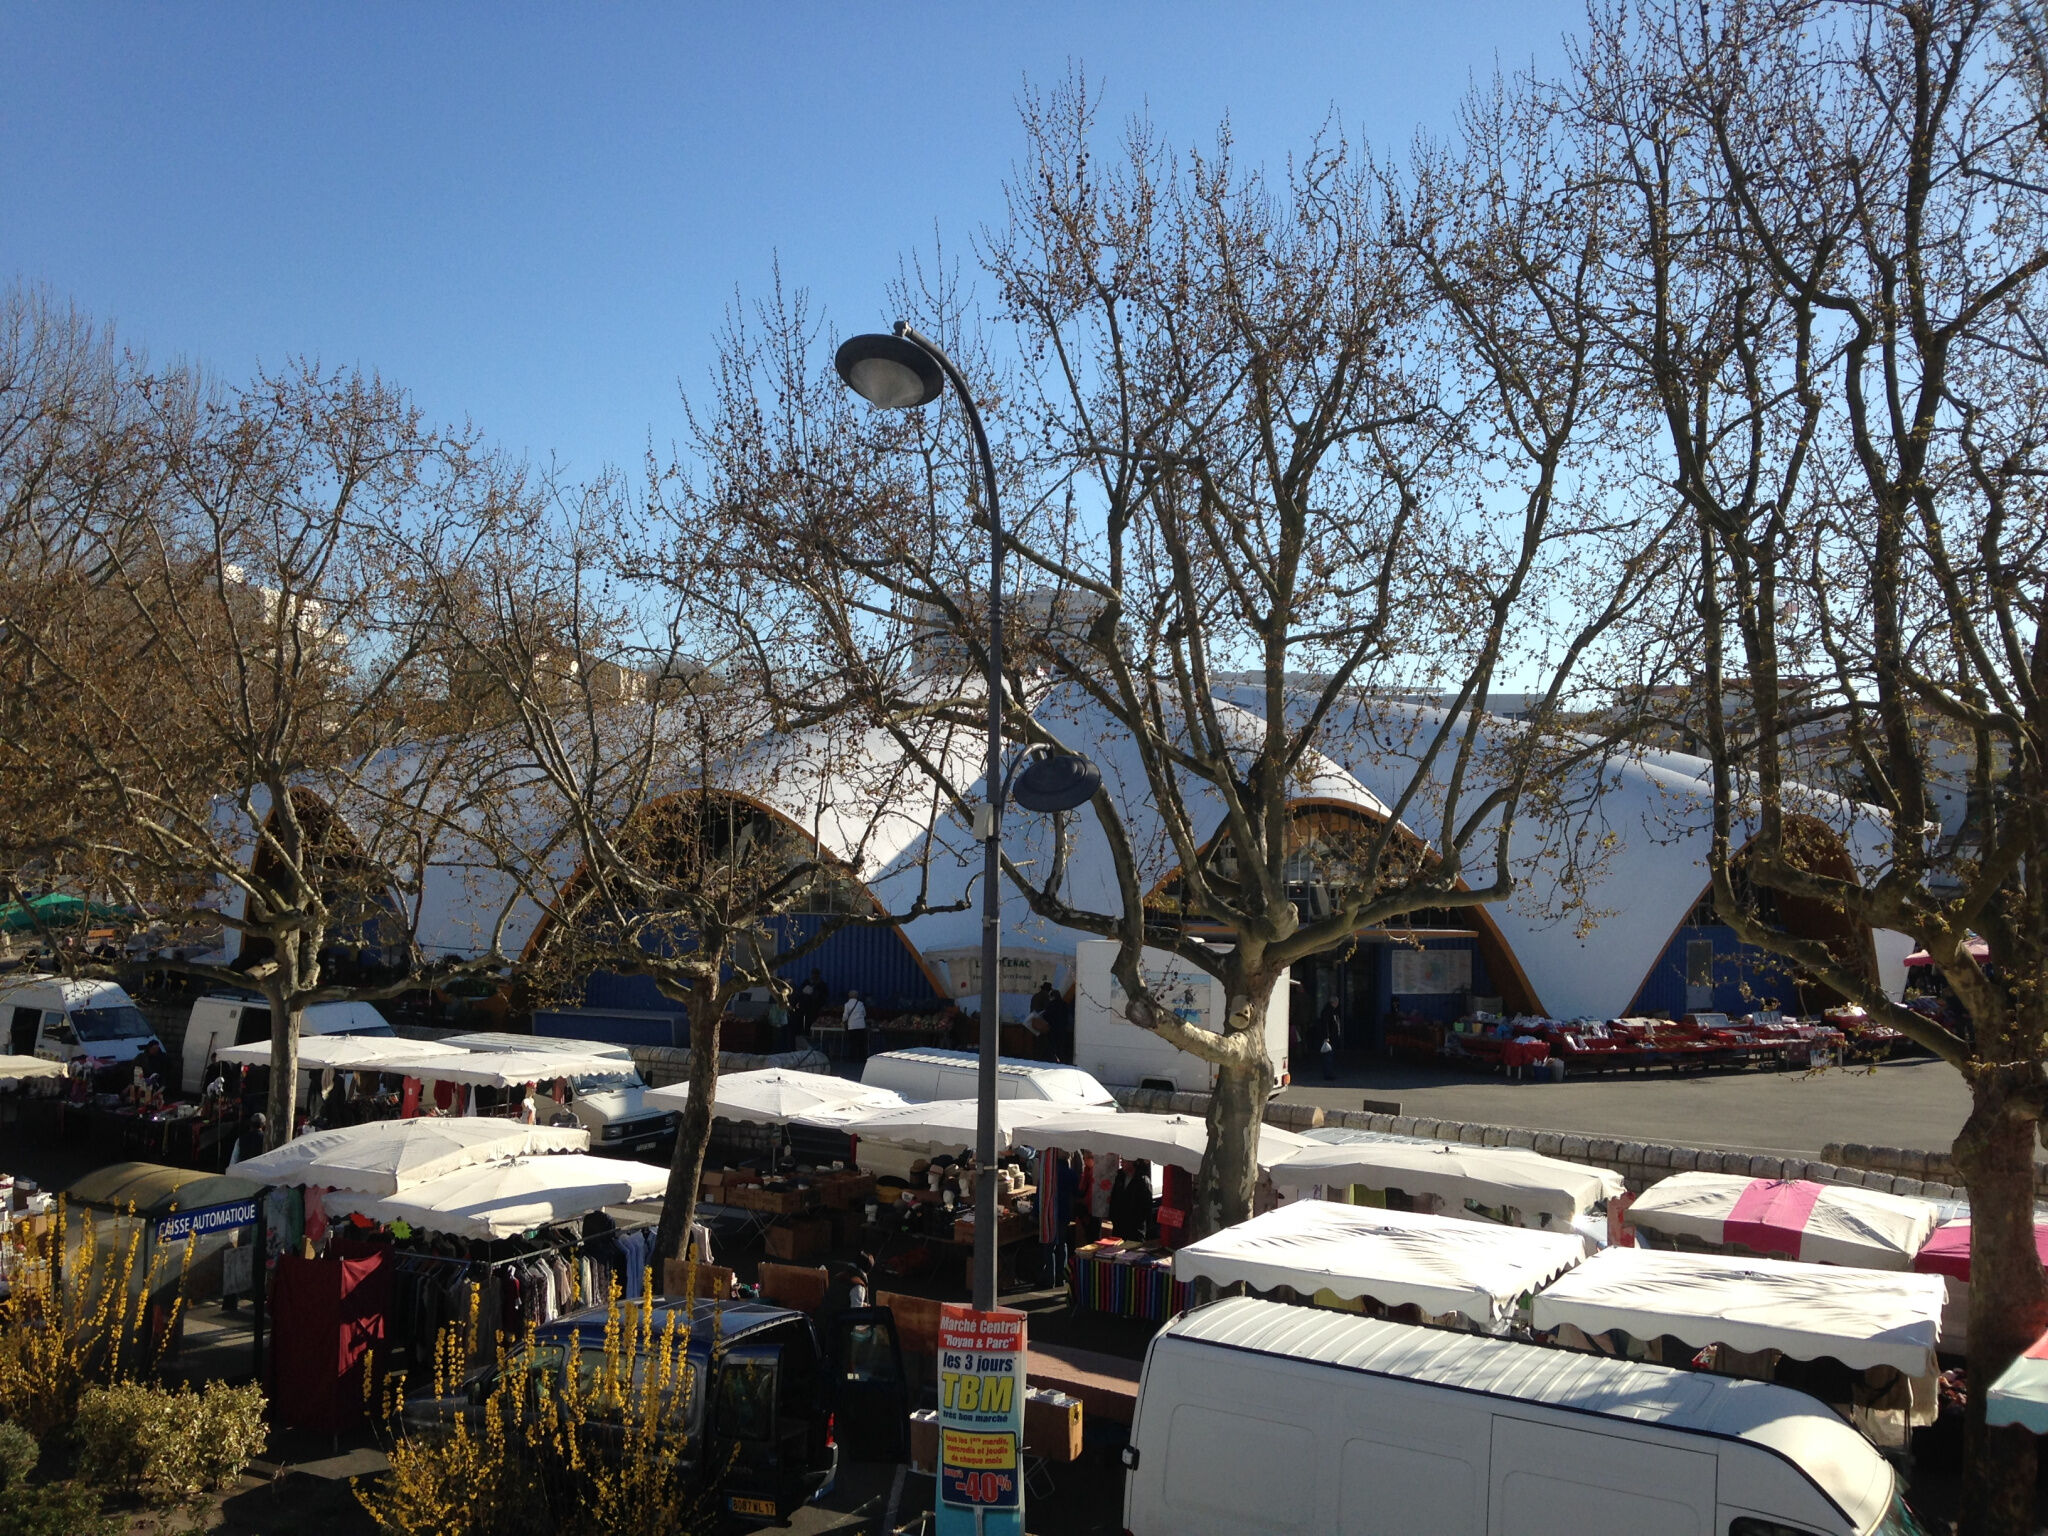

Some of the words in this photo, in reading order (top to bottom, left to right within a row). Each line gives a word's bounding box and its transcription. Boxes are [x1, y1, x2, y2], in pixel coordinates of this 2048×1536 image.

[159, 1217, 190, 1237] CAISSE
[192, 1204, 255, 1230] AUTOMATIQUE
[941, 1316, 977, 1333] Marché
[980, 1318, 1021, 1334] Central
[976, 1339, 983, 1348] &
[943, 1352, 961, 1369] les
[965, 1354, 973, 1370] 3
[942, 1371, 1015, 1413] TBM
[958, 1412, 973, 1422] bon
[975, 1413, 1008, 1423] marché
[959, 1436, 968, 1444] les
[946, 1444, 976, 1454] mercredis
[986, 1446, 1008, 1456] jeudis
[960, 1455, 983, 1464] chaque
[955, 1472, 1012, 1503] -40%
